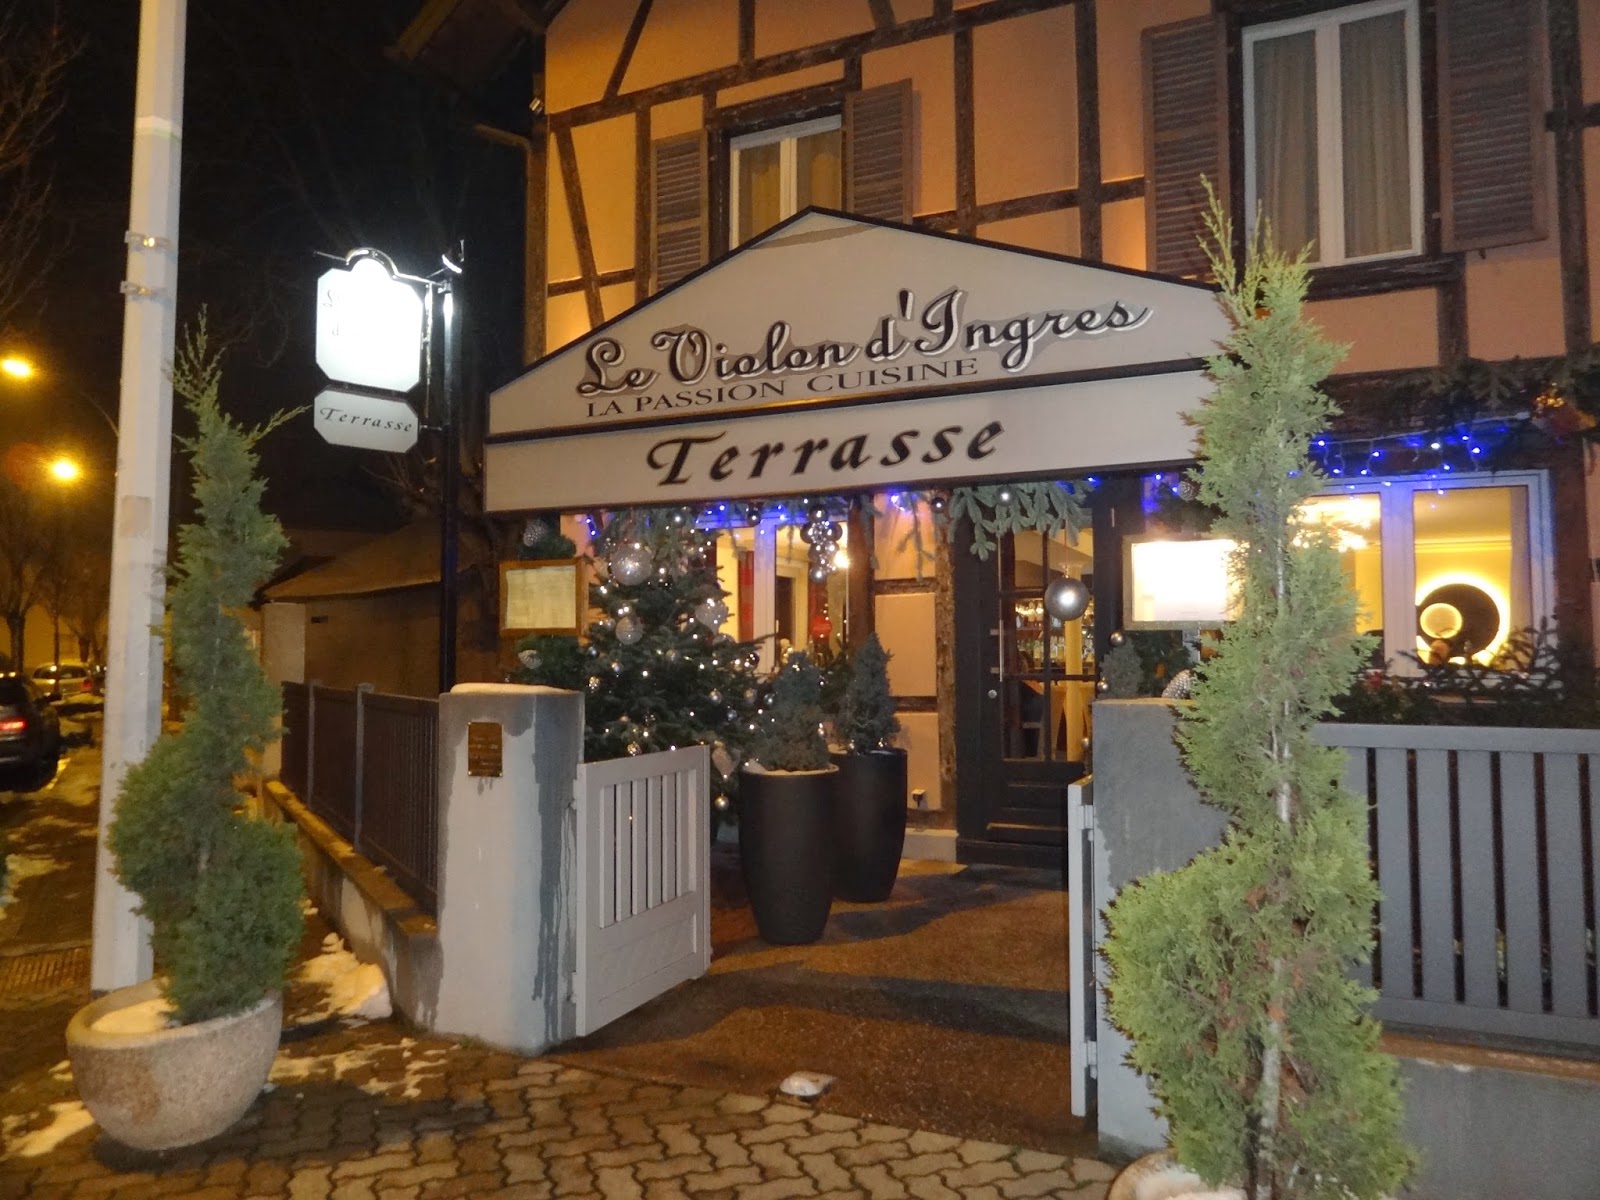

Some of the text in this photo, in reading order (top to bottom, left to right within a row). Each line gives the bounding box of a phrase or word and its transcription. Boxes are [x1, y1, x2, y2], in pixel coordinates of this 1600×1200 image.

[576, 286, 1153, 397] Le Violon d'Ingres
[319, 407, 413, 432] Terrasse
[587, 357, 978, 418] LA PASSION CUISINE
[646, 420, 1005, 487] Terrasse
